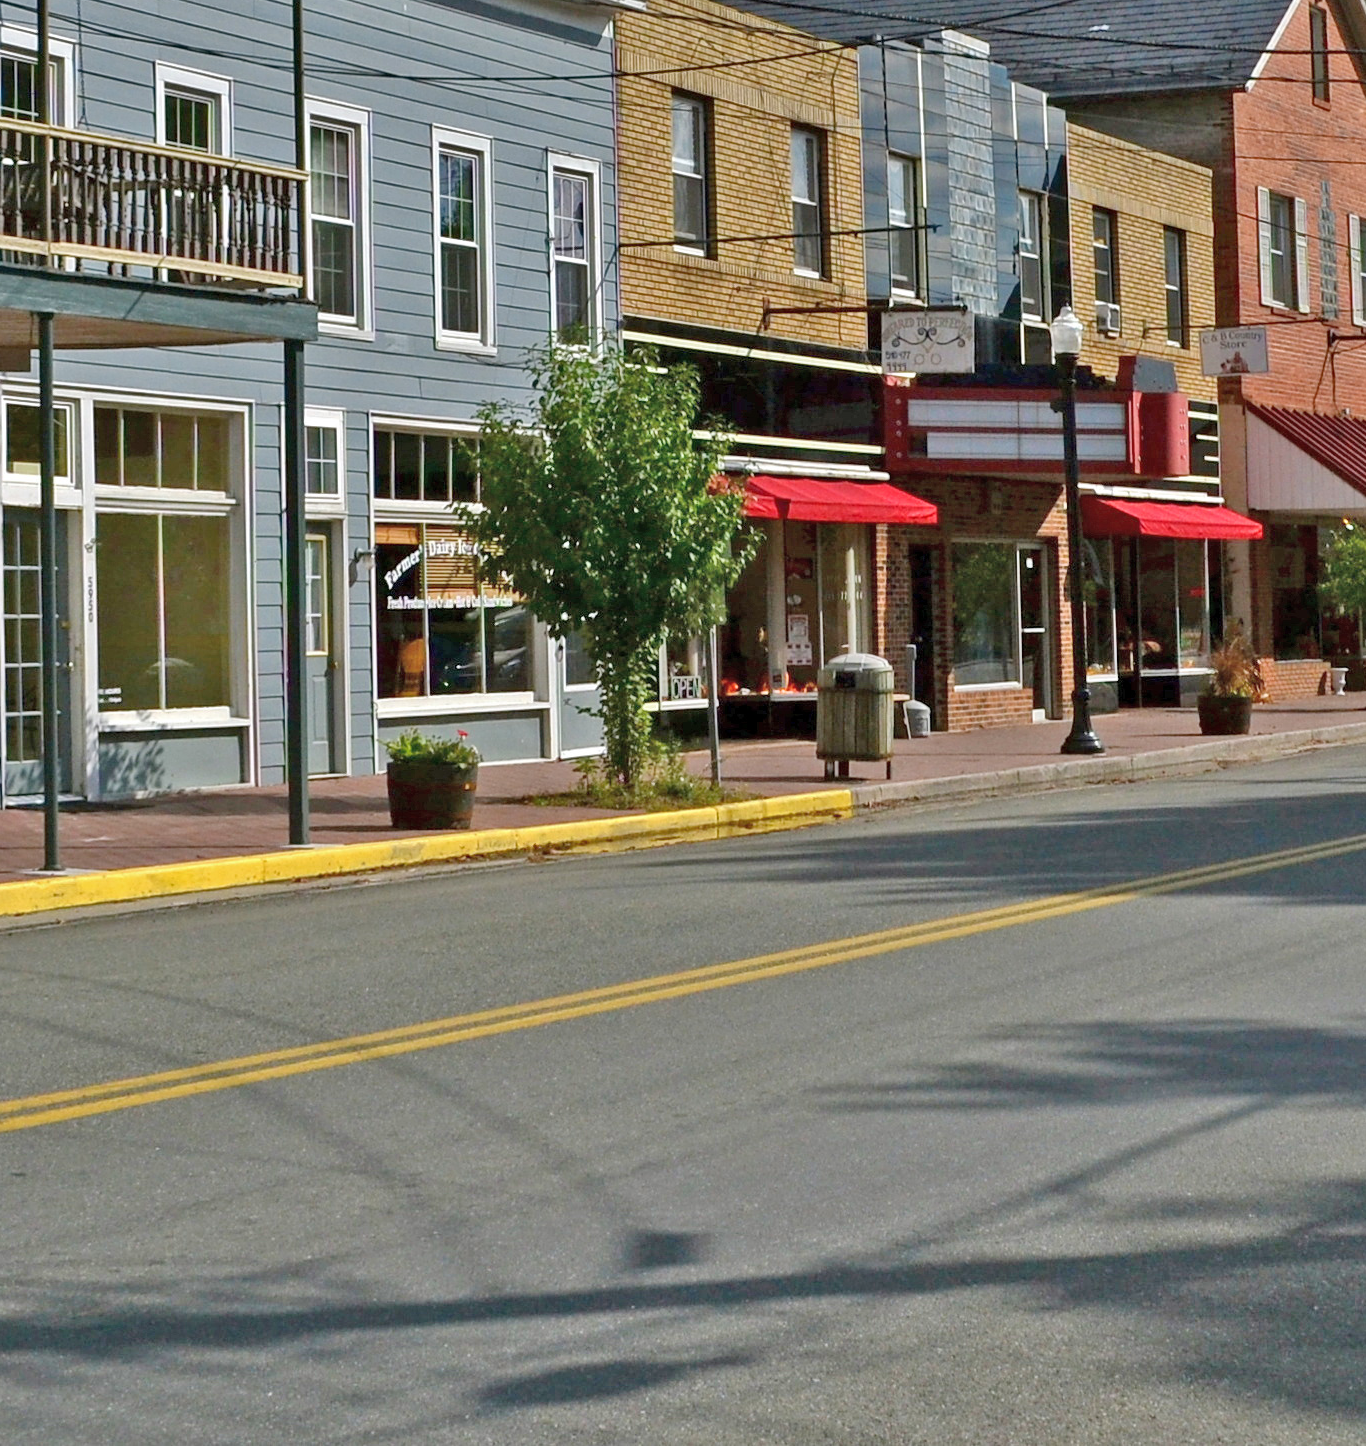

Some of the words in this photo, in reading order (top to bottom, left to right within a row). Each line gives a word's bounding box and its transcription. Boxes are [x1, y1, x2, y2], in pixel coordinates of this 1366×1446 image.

[1229, 331, 1262, 343] Country
[1220, 341, 1247, 349] Store
[672, 677, 700, 700] OPEN
